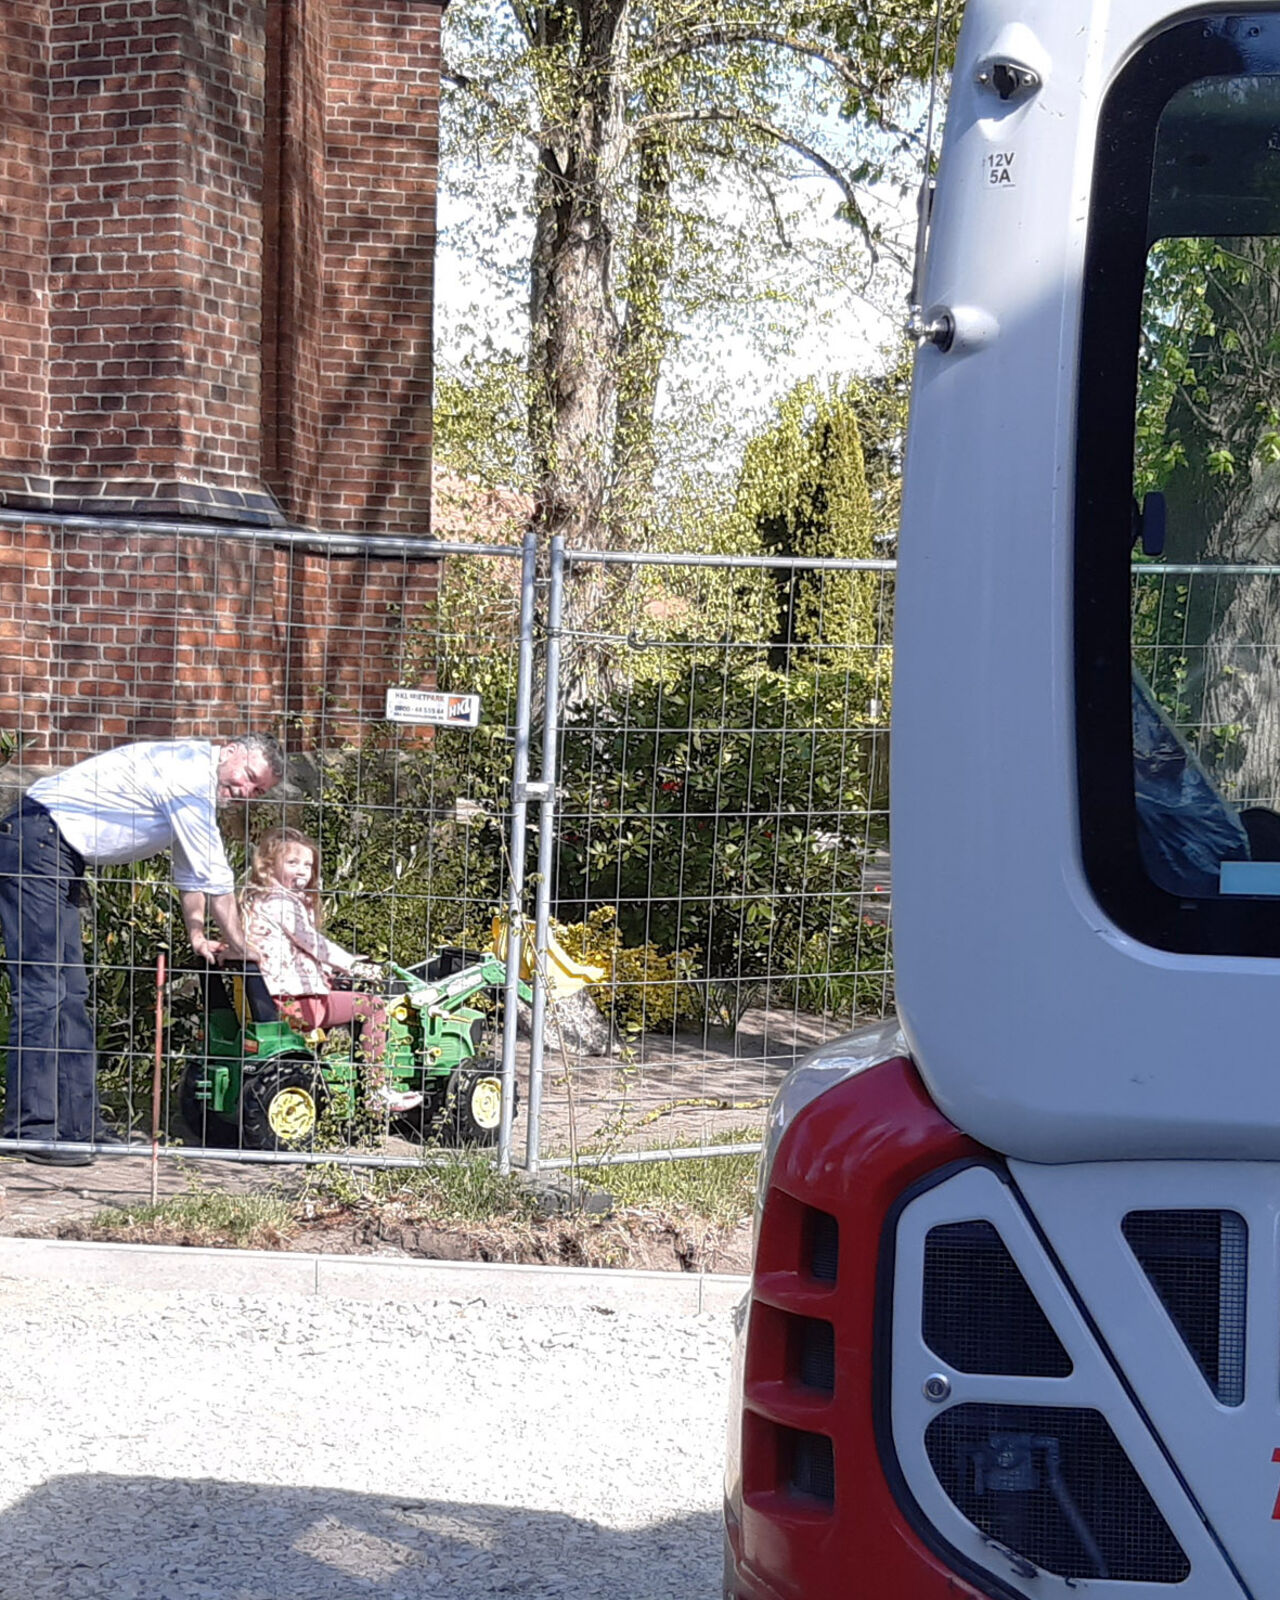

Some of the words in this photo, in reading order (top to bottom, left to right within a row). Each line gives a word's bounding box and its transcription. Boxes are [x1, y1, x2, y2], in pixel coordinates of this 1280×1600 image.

[988, 152, 1014, 167] 12V
[990, 169, 1011, 184] 5A
[449, 699, 471, 717] HKL
